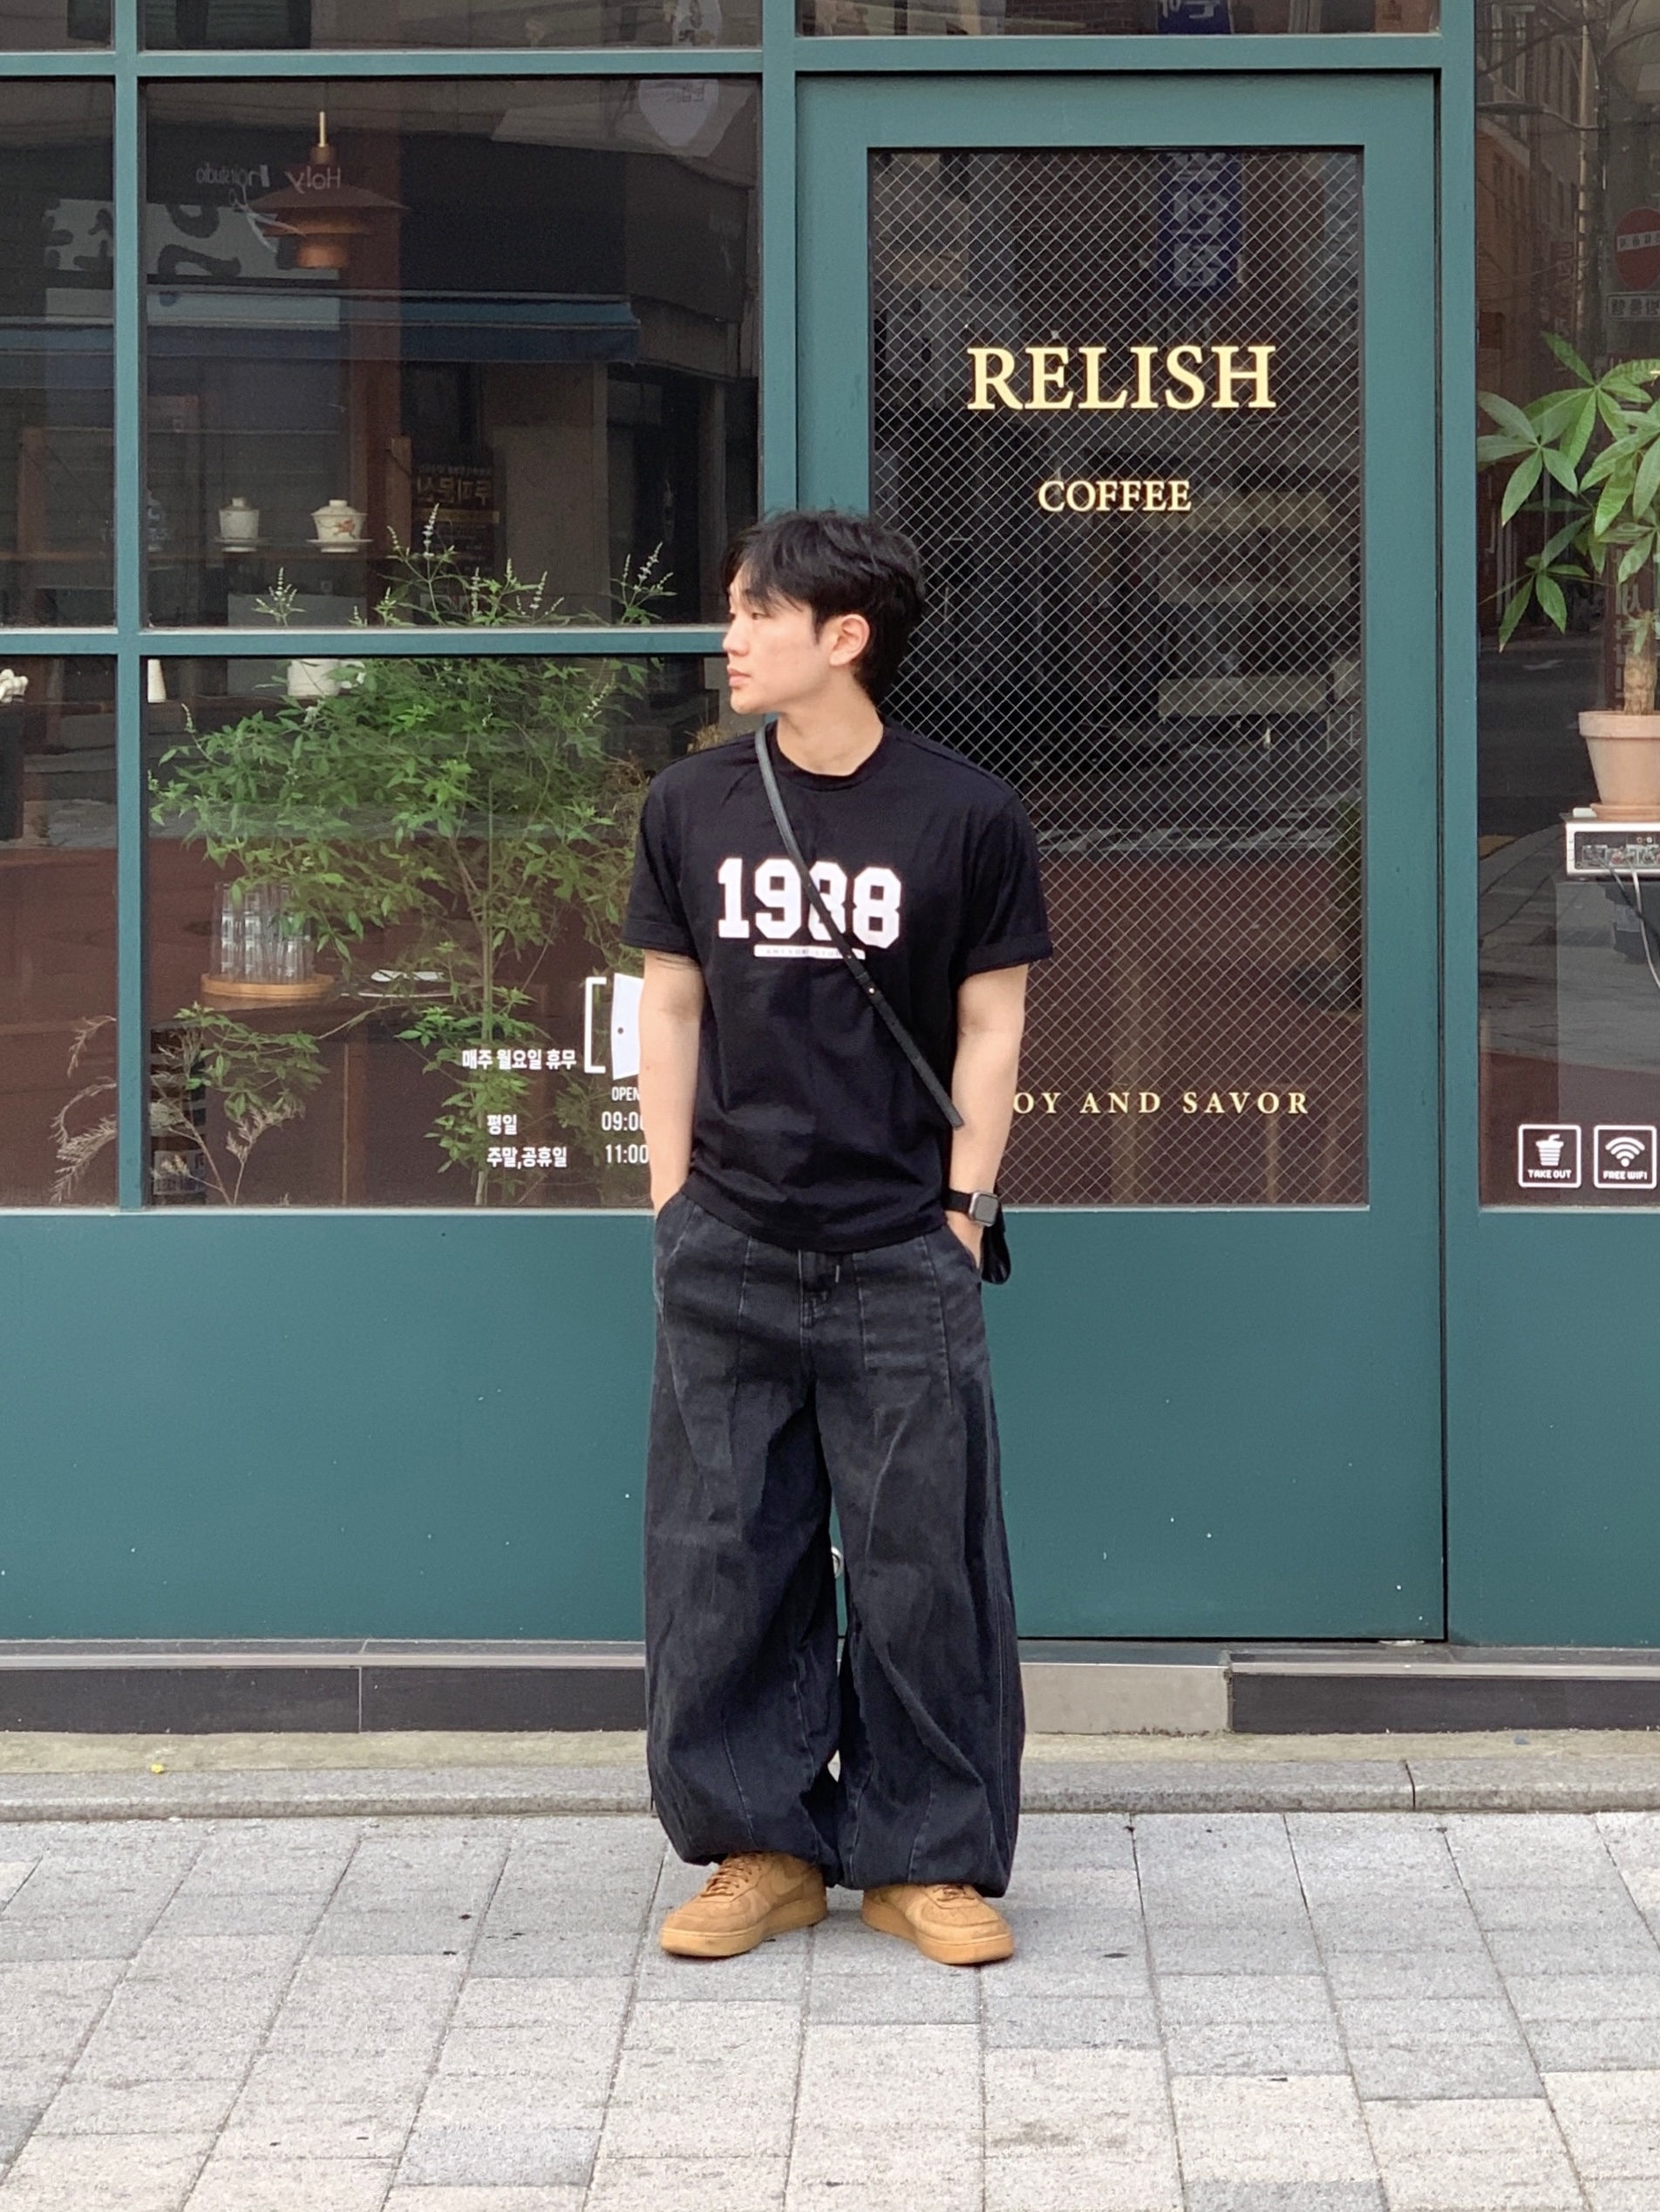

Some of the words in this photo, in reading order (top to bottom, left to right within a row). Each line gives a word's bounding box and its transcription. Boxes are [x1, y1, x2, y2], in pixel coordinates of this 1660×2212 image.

[968, 344, 1277, 412] RELISH
[1038, 480, 1192, 513] COFFEE
[718, 857, 901, 949] 1988
[461, 1049, 493, 1071] 매주
[496, 1049, 541, 1071] 월요일
[546, 1049, 577, 1071] 휴무
[611, 1086, 640, 1102] OPEN
[1012, 1092, 1061, 1114] OY
[1080, 1092, 1161, 1113] AND
[1183, 1092, 1310, 1114] SAVOR
[486, 1114, 518, 1136] 평일
[486, 1146, 568, 1169] 주말,공휴일
[605, 1144, 650, 1165] 11:00
[1527, 1169, 1552, 1180] TAKE
[1554, 1169, 1572, 1180] OUT
[1602, 1170, 1626, 1181] FREE
